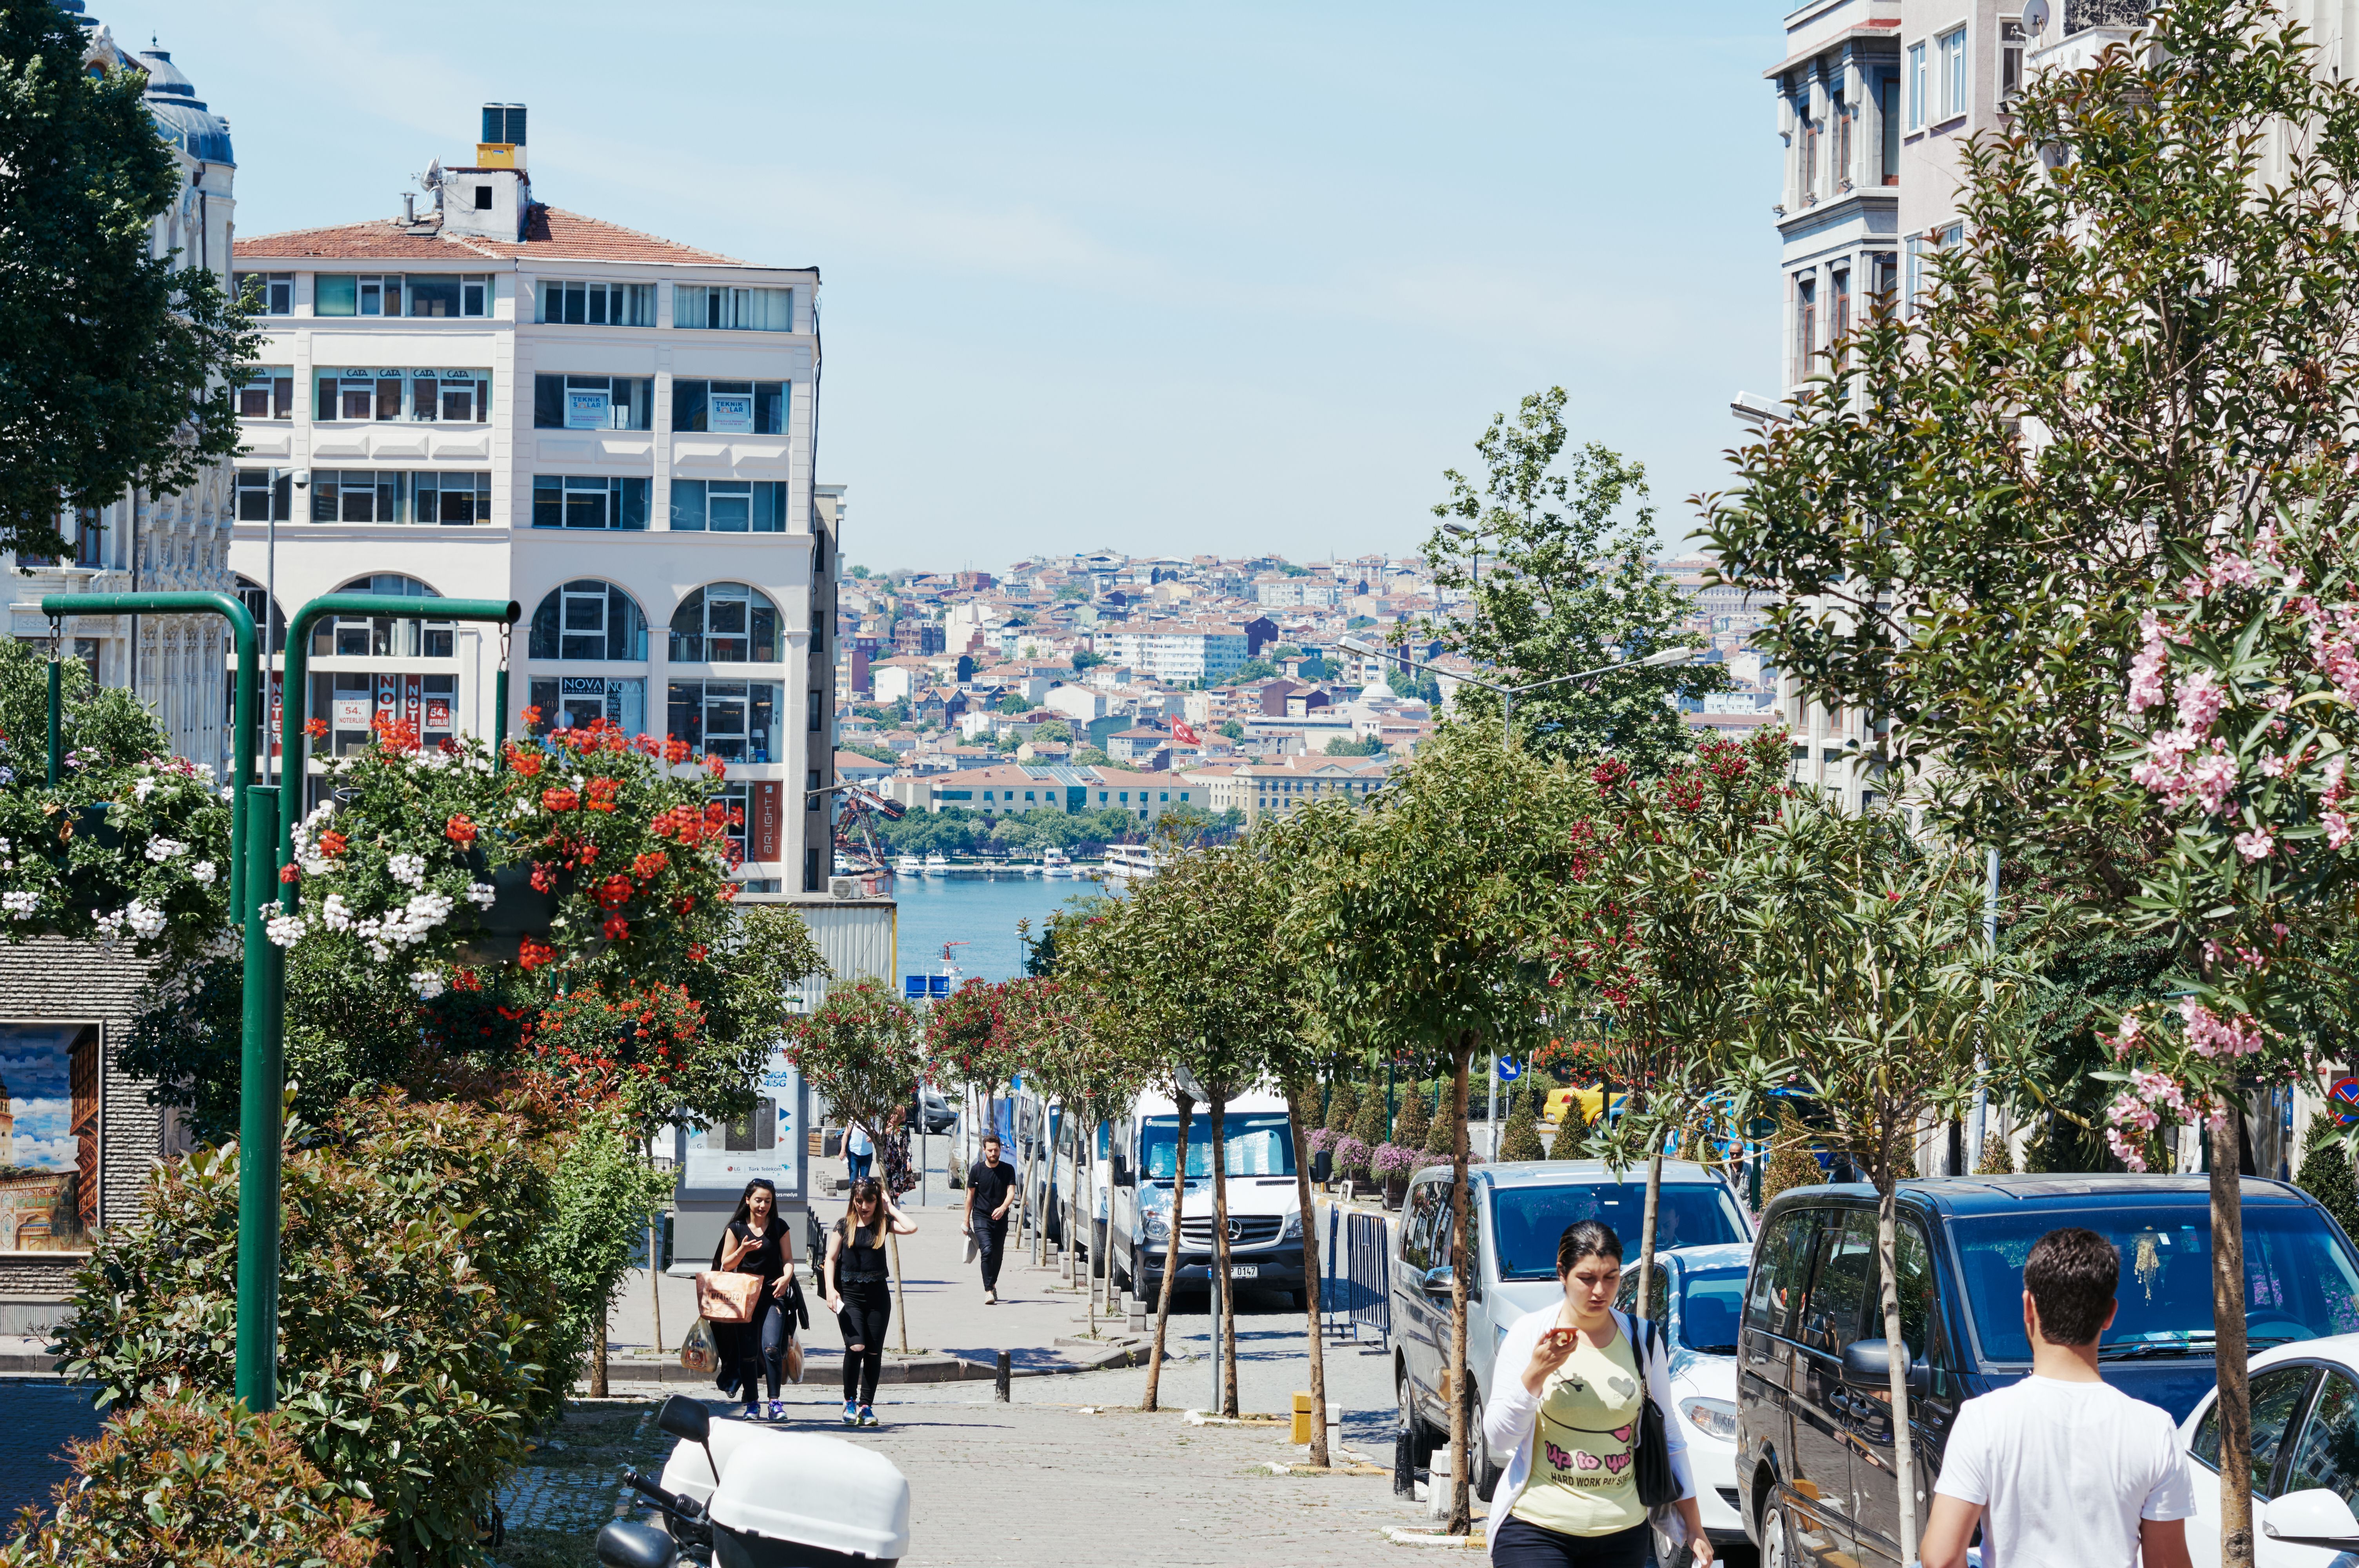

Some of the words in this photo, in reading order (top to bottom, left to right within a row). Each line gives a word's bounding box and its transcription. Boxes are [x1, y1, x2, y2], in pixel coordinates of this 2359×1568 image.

[564, 679, 602, 690] NOVA
[607, 681, 641, 692] NOVA
[380, 675, 394, 722] NOT
[272, 682, 282, 744] NOTER
[408, 685, 418, 734] NOTE
[430, 707, 447, 717] 54.
[1146, 1118, 1152, 1126] 6
[1238, 1267, 1255, 1275] 0147
[1576, 1451, 1602, 1470] to
[1551, 1472, 1574, 1486] HARD
[1576, 1477, 1601, 1487] WORK
[1603, 1477, 1617, 1486] PAY
